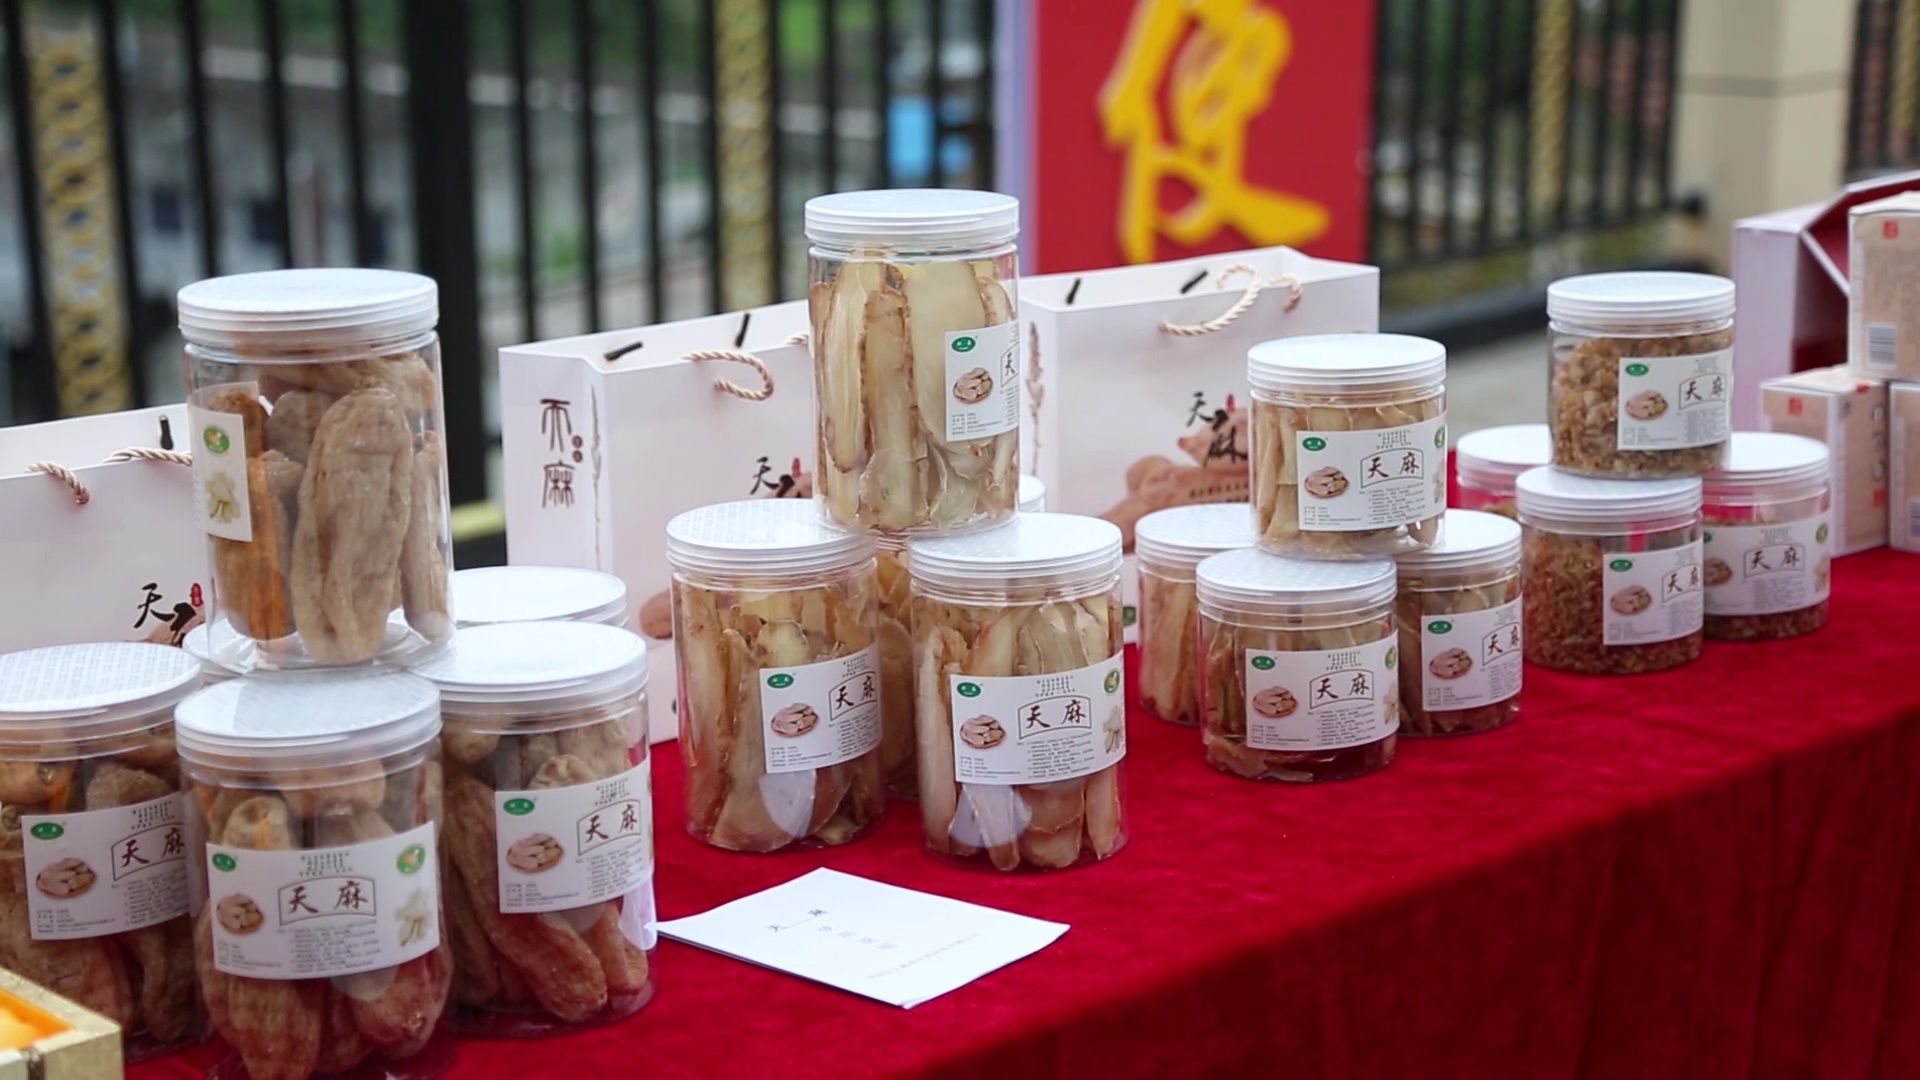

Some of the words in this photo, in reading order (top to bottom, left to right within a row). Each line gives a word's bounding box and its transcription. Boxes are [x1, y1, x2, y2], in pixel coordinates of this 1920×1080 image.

[1685, 376, 1723, 401] 天麻
[1368, 452, 1420, 479] 天麻
[1750, 547, 1801, 571] 天麻
[836, 675, 876, 709] 天麻
[1317, 673, 1370, 700] 天麻
[1026, 700, 1087, 729] 天麻
[585, 804, 638, 843] 天麻
[121, 827, 185, 868] 天麻
[289, 880, 368, 914] 天麻
